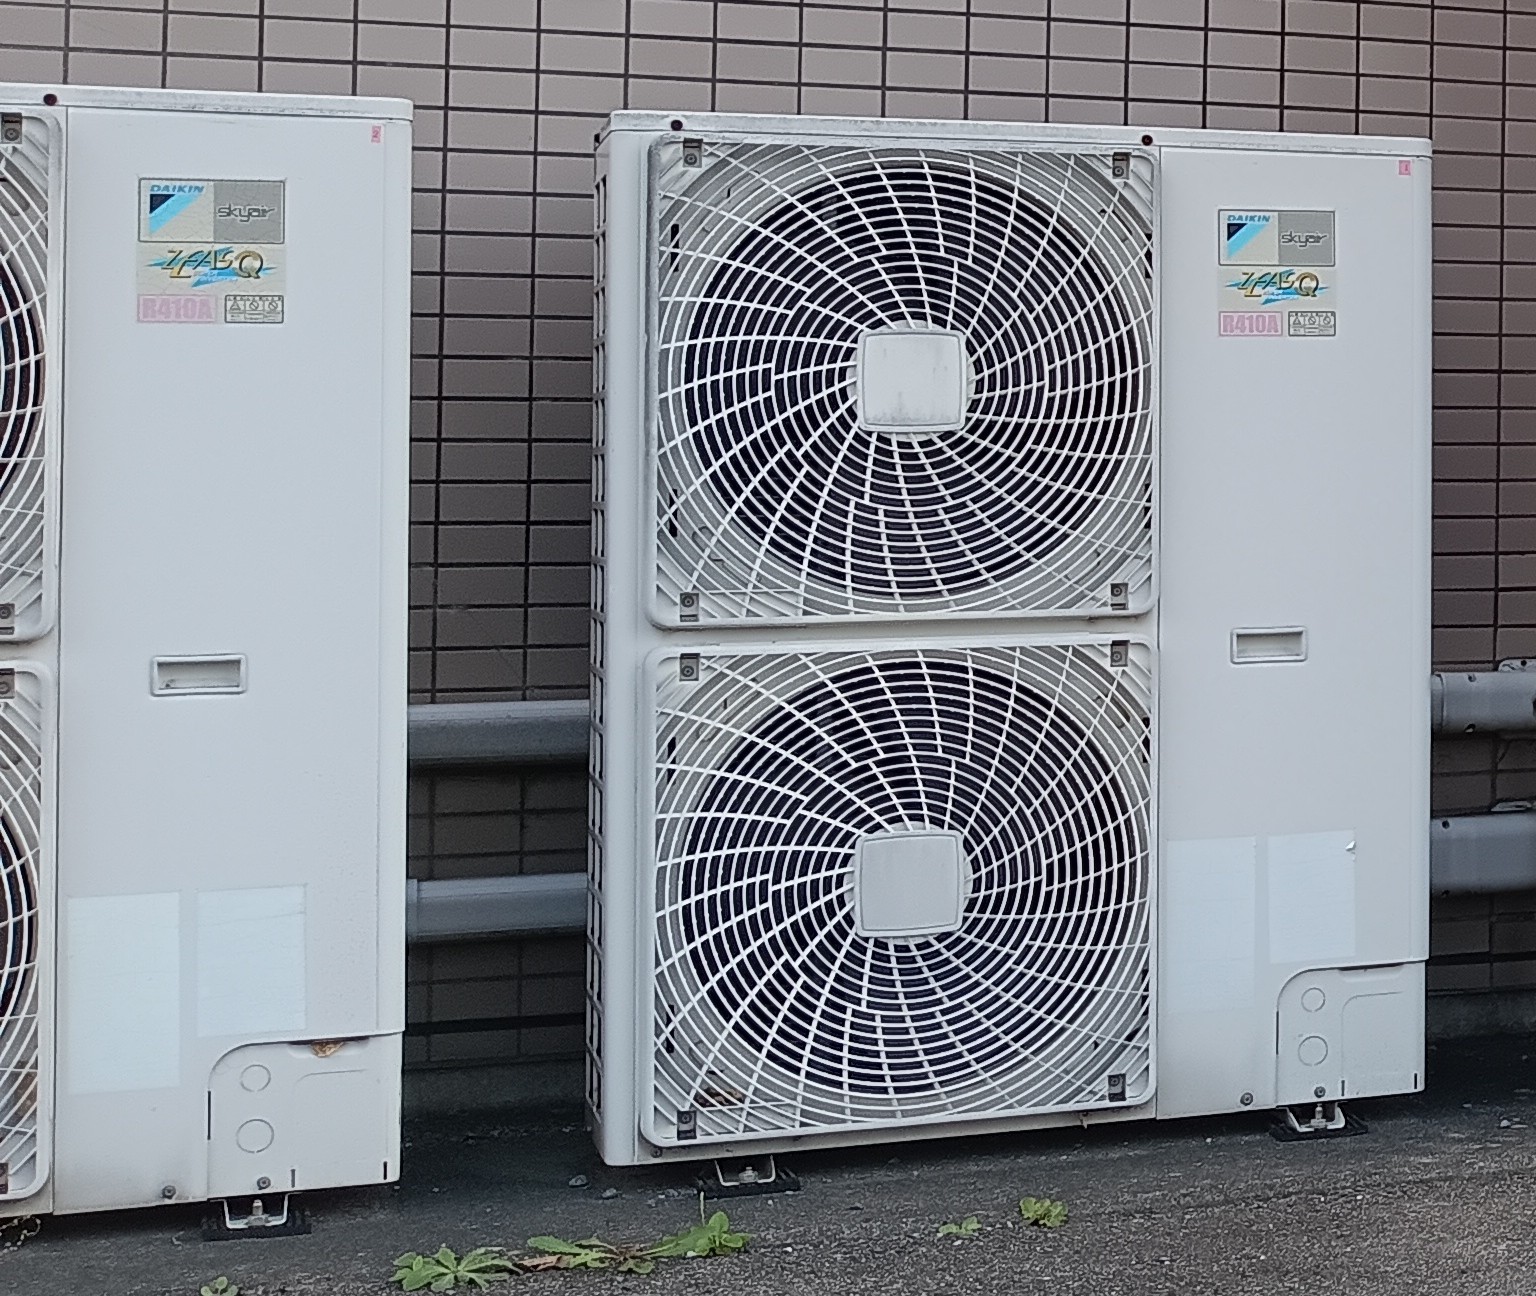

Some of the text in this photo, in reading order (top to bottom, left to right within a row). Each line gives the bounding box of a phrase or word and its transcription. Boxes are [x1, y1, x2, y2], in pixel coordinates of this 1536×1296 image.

[149, 184, 205, 193] DAIKIN
[217, 203, 276, 223] skyair
[1226, 214, 1271, 223] DAIKIN
[1280, 230, 1328, 248] skyair
[141, 297, 213, 320] R410A
[1222, 314, 1279, 334] R410A
